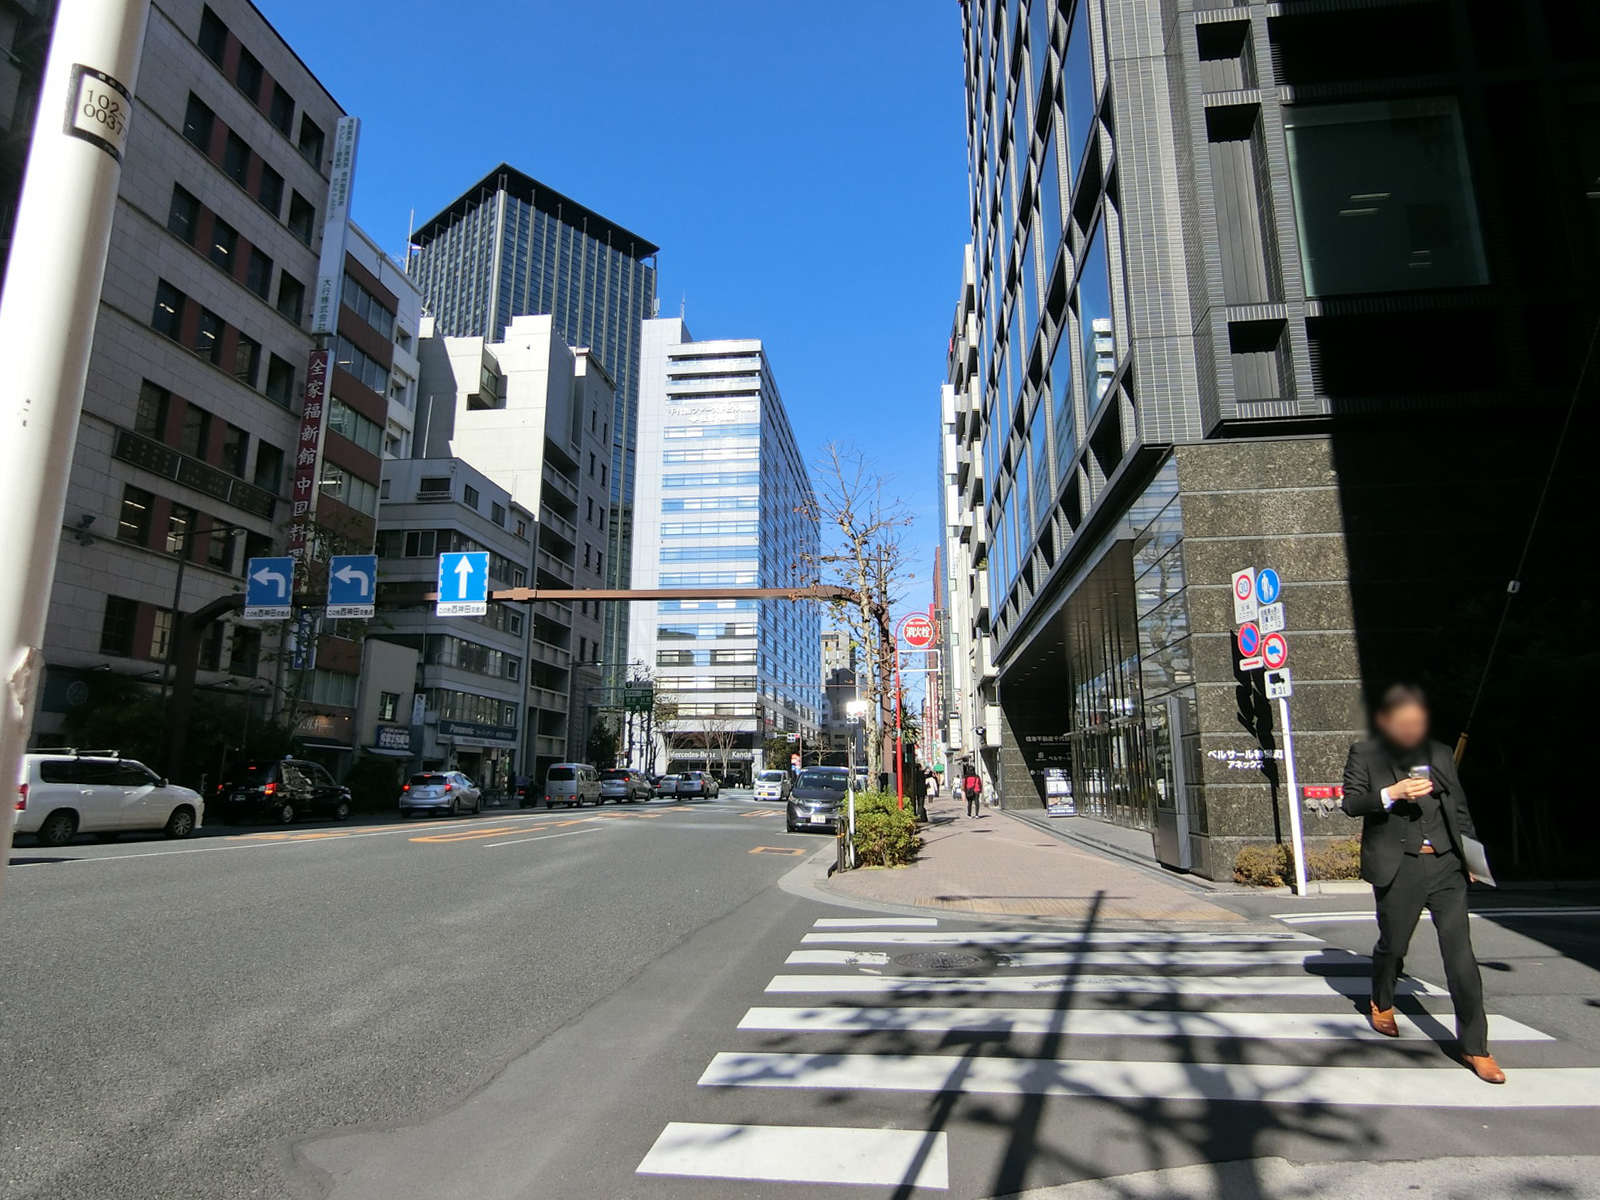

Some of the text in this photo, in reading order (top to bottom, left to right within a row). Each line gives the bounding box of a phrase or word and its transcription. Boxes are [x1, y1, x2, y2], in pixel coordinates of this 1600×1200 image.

[83, 103, 125, 135] 0037
[318, 278, 332, 331] 大行株式会社
[298, 358, 326, 466] 全家福新館
[1239, 581, 1249, 594] 30
[328, 607, 373, 616] この先西神田交差点
[439, 604, 485, 614] この先西神田交差点
[906, 626, 931, 638] 消火栓
[450, 724, 475, 736] Panasonic
[732, 751, 752, 759] Kanda
[1226, 760, 1265, 770] アネックス
